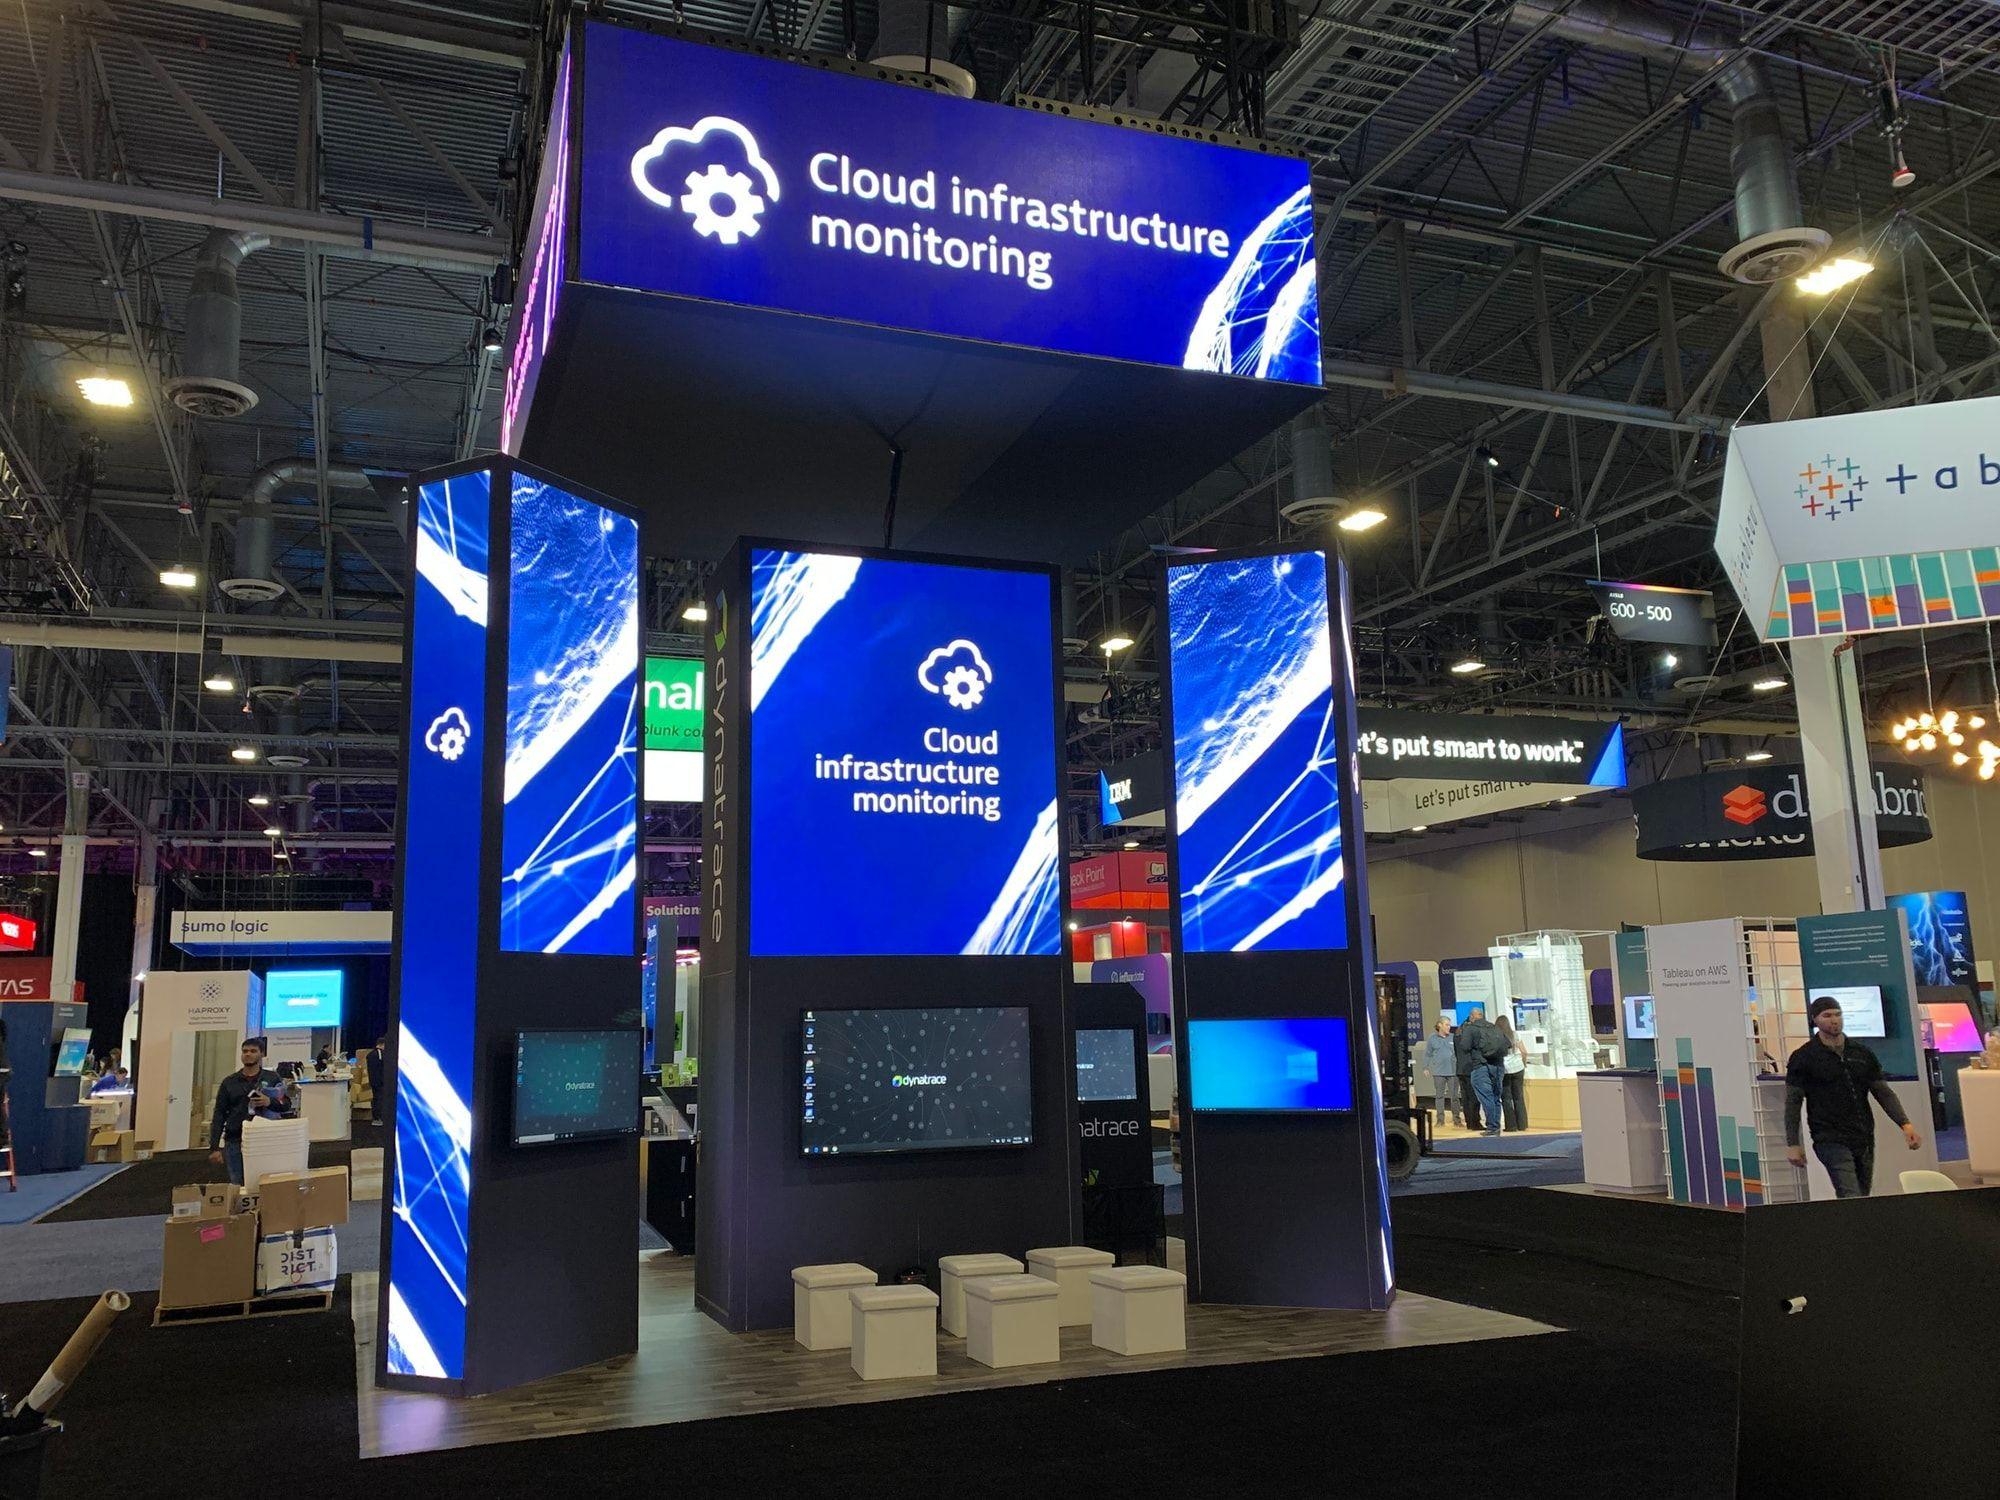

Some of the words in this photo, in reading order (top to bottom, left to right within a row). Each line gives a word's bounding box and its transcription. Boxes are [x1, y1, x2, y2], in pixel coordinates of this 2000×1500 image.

[809, 153, 936, 210] Cloud
[951, 176, 1230, 258] infrastructure
[811, 213, 1053, 290] monitoring
[1609, 602, 1636, 619] 600
[1646, 605, 1673, 621] 500
[684, 727, 706, 738] co
[923, 727, 998, 756] Cloud
[1392, 735, 1430, 760] put
[1433, 738, 1496, 760] smart
[1498, 739, 1520, 761] to
[815, 754, 1000, 785] infrastructure
[713, 657, 727, 942] dynatrace
[853, 788, 1001, 821] monitoring
[1108, 778, 1132, 805] IBM
[1415, 789, 1445, 810] Let's
[1448, 783, 1470, 807] put
[1085, 864, 1105, 884] Point
[646, 904, 702, 916] Solution
[181, 921, 226, 933] sumo
[230, 919, 269, 935] logic
[1662, 967, 1694, 979] Tableau
[1695, 968, 1706, 977] on
[1708, 964, 1728, 976] AWS
[188, 1006, 231, 1014] HAPROXY
[902, 1074, 947, 1087] dynatrace
